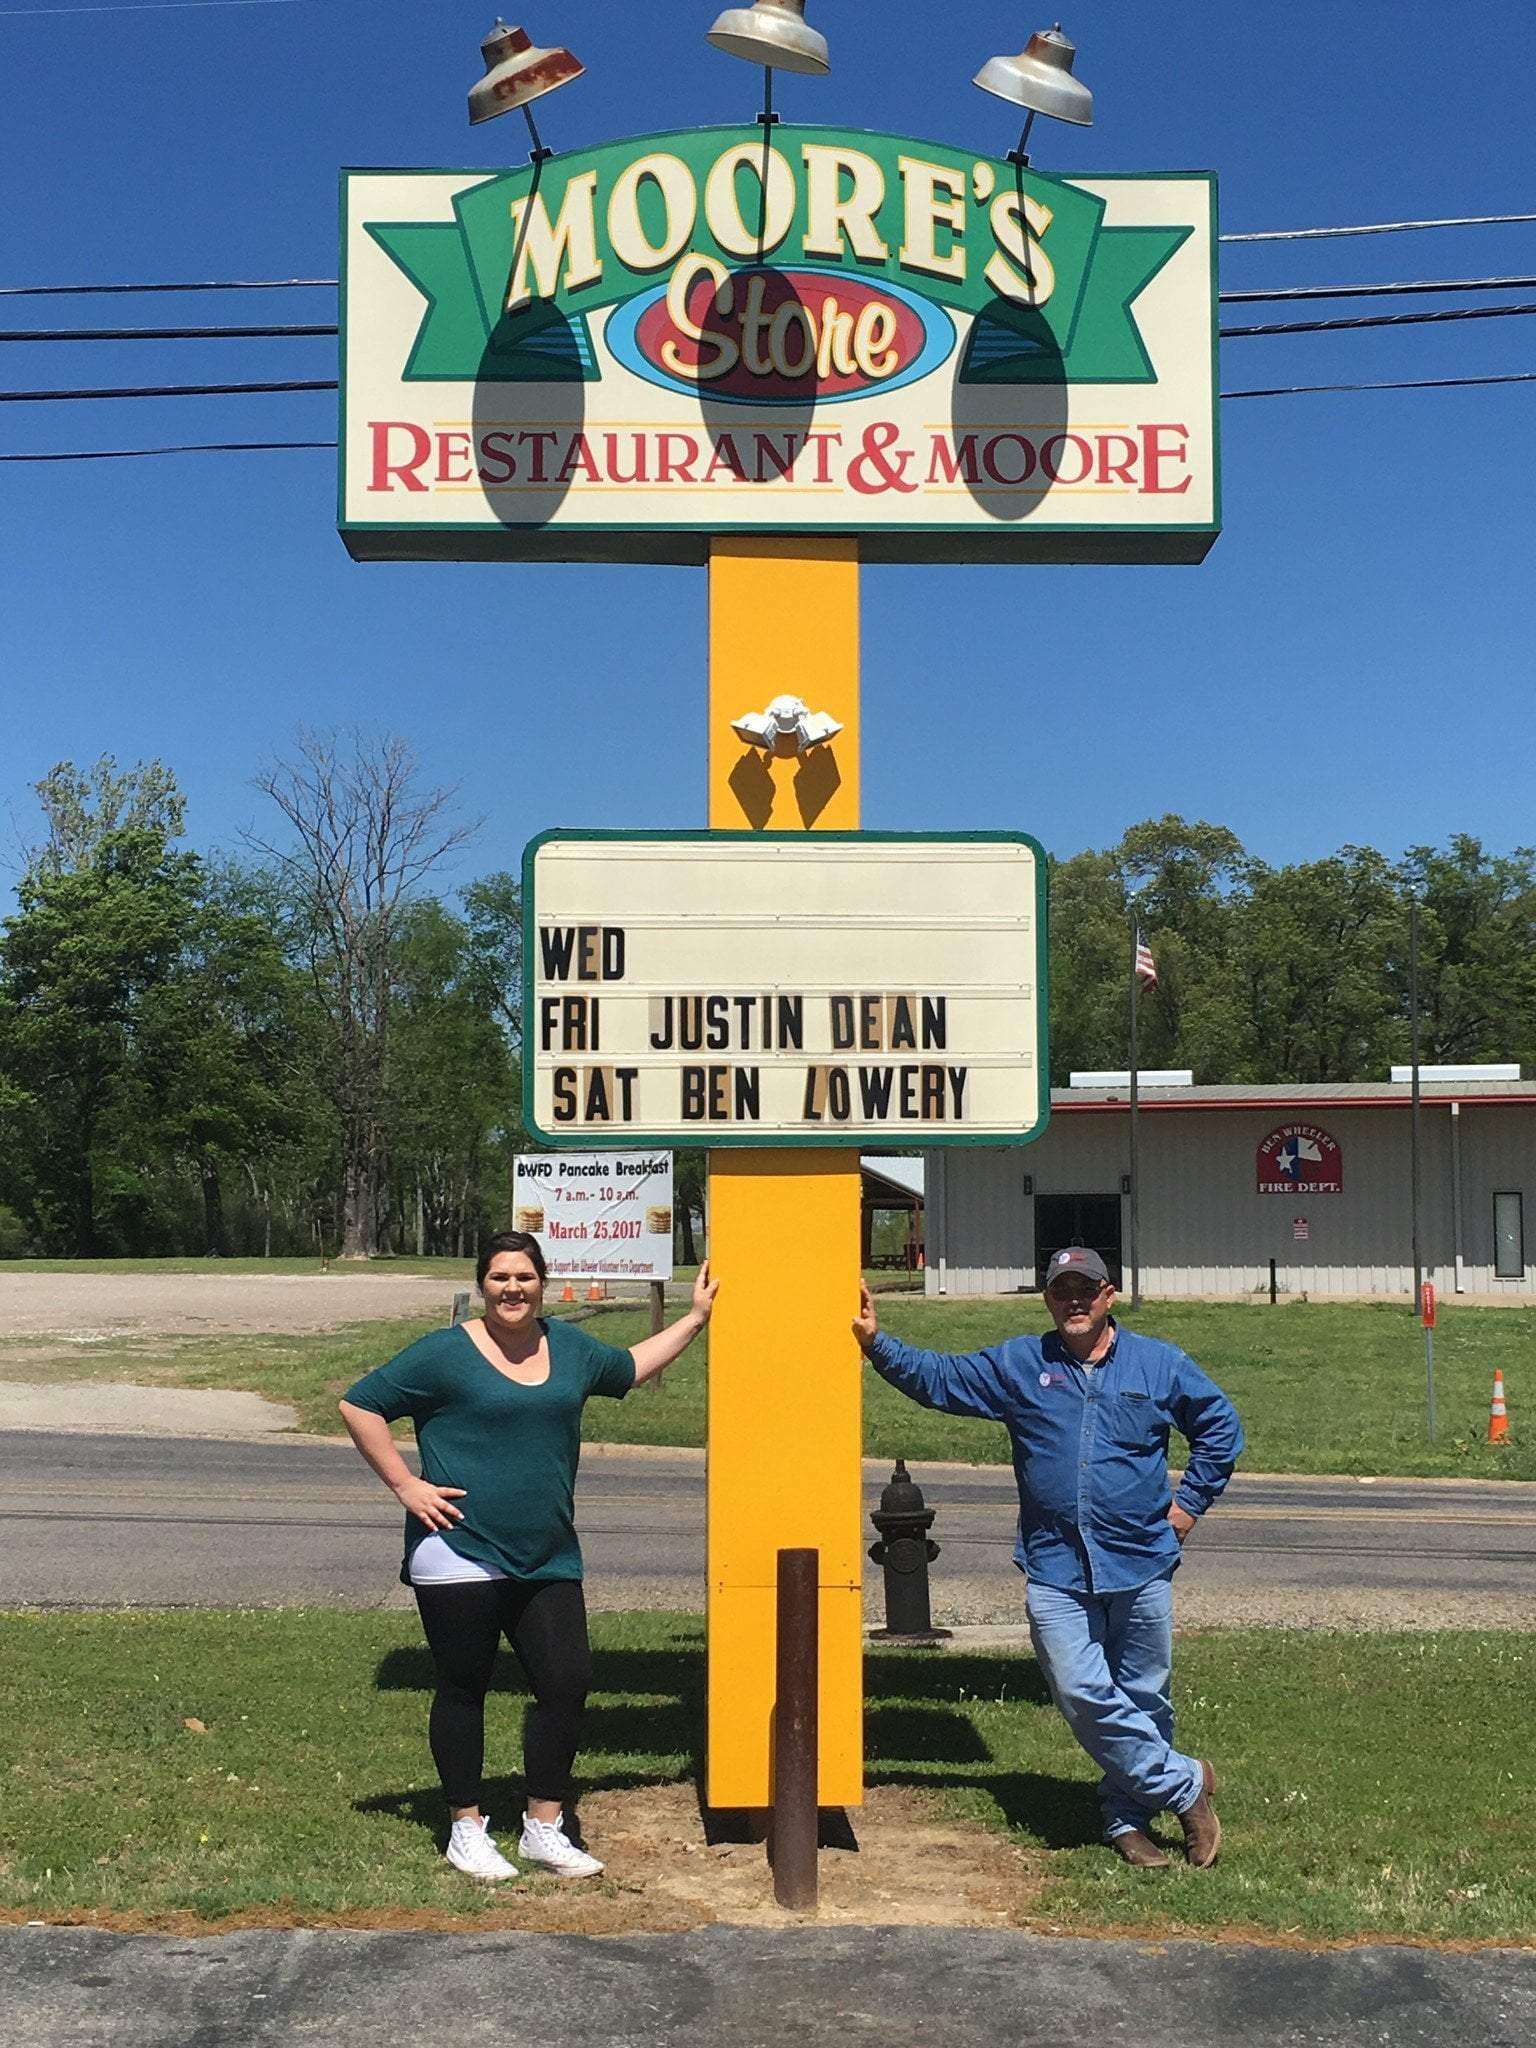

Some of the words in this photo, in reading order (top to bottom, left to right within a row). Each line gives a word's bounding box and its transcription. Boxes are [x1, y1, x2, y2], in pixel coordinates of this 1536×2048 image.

[505, 141, 1057, 310] MOORE'S
[660, 251, 900, 381] Store
[366, 421, 842, 494] RESTAURANT
[846, 421, 920, 495] &
[925, 423, 1194, 495] MOORE
[539, 926, 626, 980] WED
[541, 996, 600, 1051] FRI
[650, 995, 801, 1050] JUSTIN
[832, 995, 946, 1050] DEAN
[553, 1067, 638, 1122] SAT
[682, 1066, 760, 1120] BEN
[803, 1065, 966, 1121] LOWERY
[1282, 1126, 1336, 1152] WHEELER
[517, 1163, 552, 1177] BWFD
[559, 1162, 609, 1177] Pancake
[616, 1159, 669, 1176] Breakfast
[555, 1188, 563, 1201] 7
[600, 1187, 613, 1200] 10
[1259, 1182, 1294, 1193] FIRE
[1298, 1182, 1340, 1193] DEPT.
[548, 1222, 588, 1239] March
